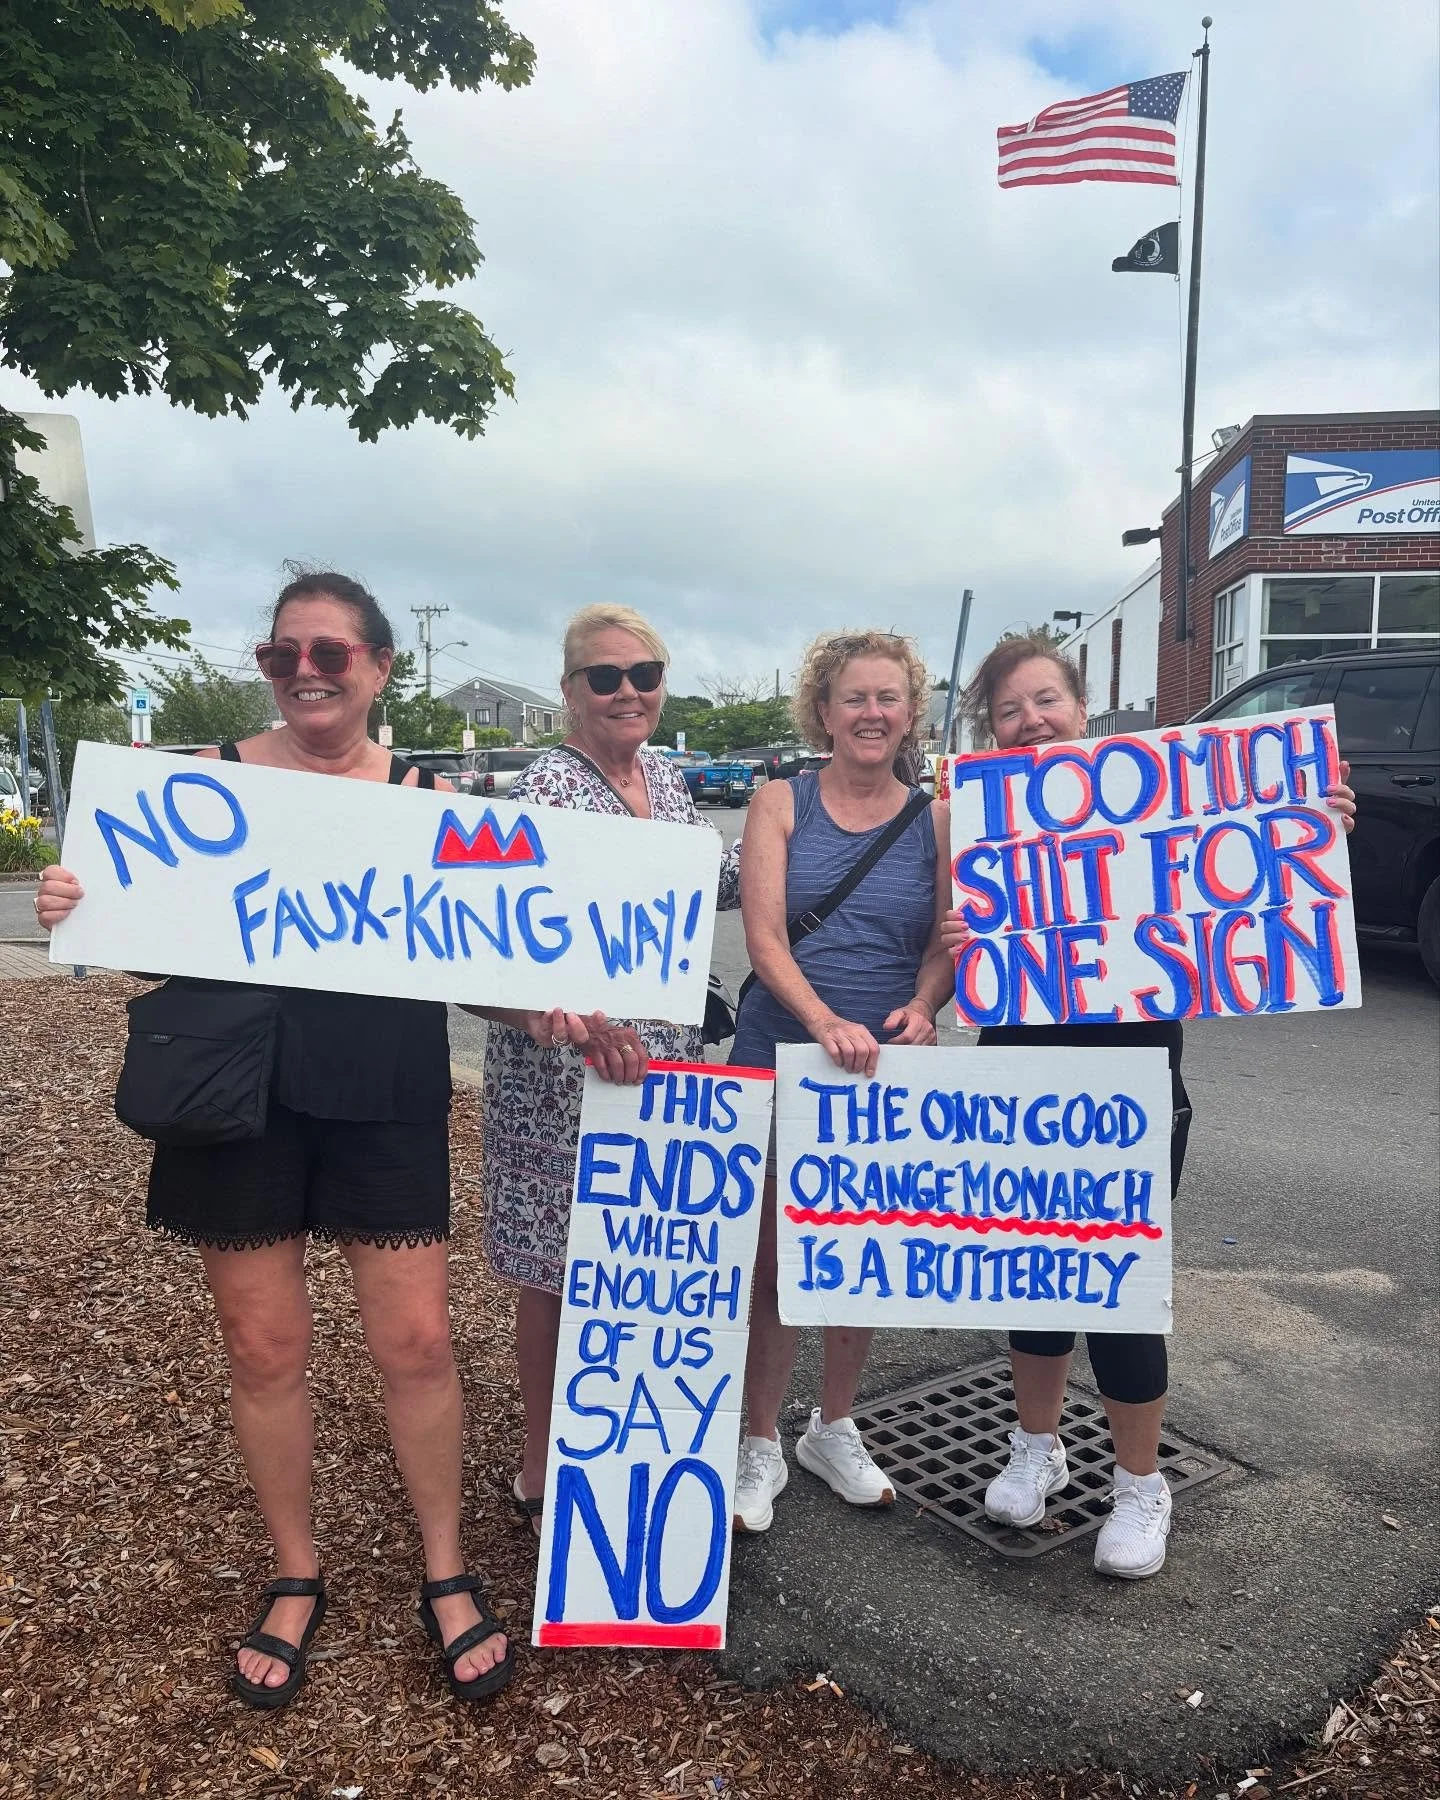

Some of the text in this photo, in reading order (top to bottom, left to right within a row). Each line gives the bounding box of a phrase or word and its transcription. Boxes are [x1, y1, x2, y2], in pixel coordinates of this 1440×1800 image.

[1358, 508, 1406, 524] Post
[954, 716, 1341, 843] TOO MUCH
[95, 771, 250, 891] NO
[1140, 804, 1350, 916] FOR
[231, 866, 703, 985] FAUX-KING WAY!
[954, 899, 1347, 1027] ONE SIGN
[639, 1071, 743, 1134] THIS
[798, 1076, 1149, 1149] THE ONLY GOOD
[577, 1132, 763, 1219] ENDS
[789, 1153, 1155, 1226] ORANGE MONARCH
[602, 1208, 719, 1265] WHEN
[797, 1235, 1142, 1310] IS A BUTTERFLY
[568, 1259, 742, 1321] ENOUGH
[578, 1318, 714, 1369] OF US
[555, 1365, 732, 1461] SAY
[545, 1457, 728, 1625] NO
